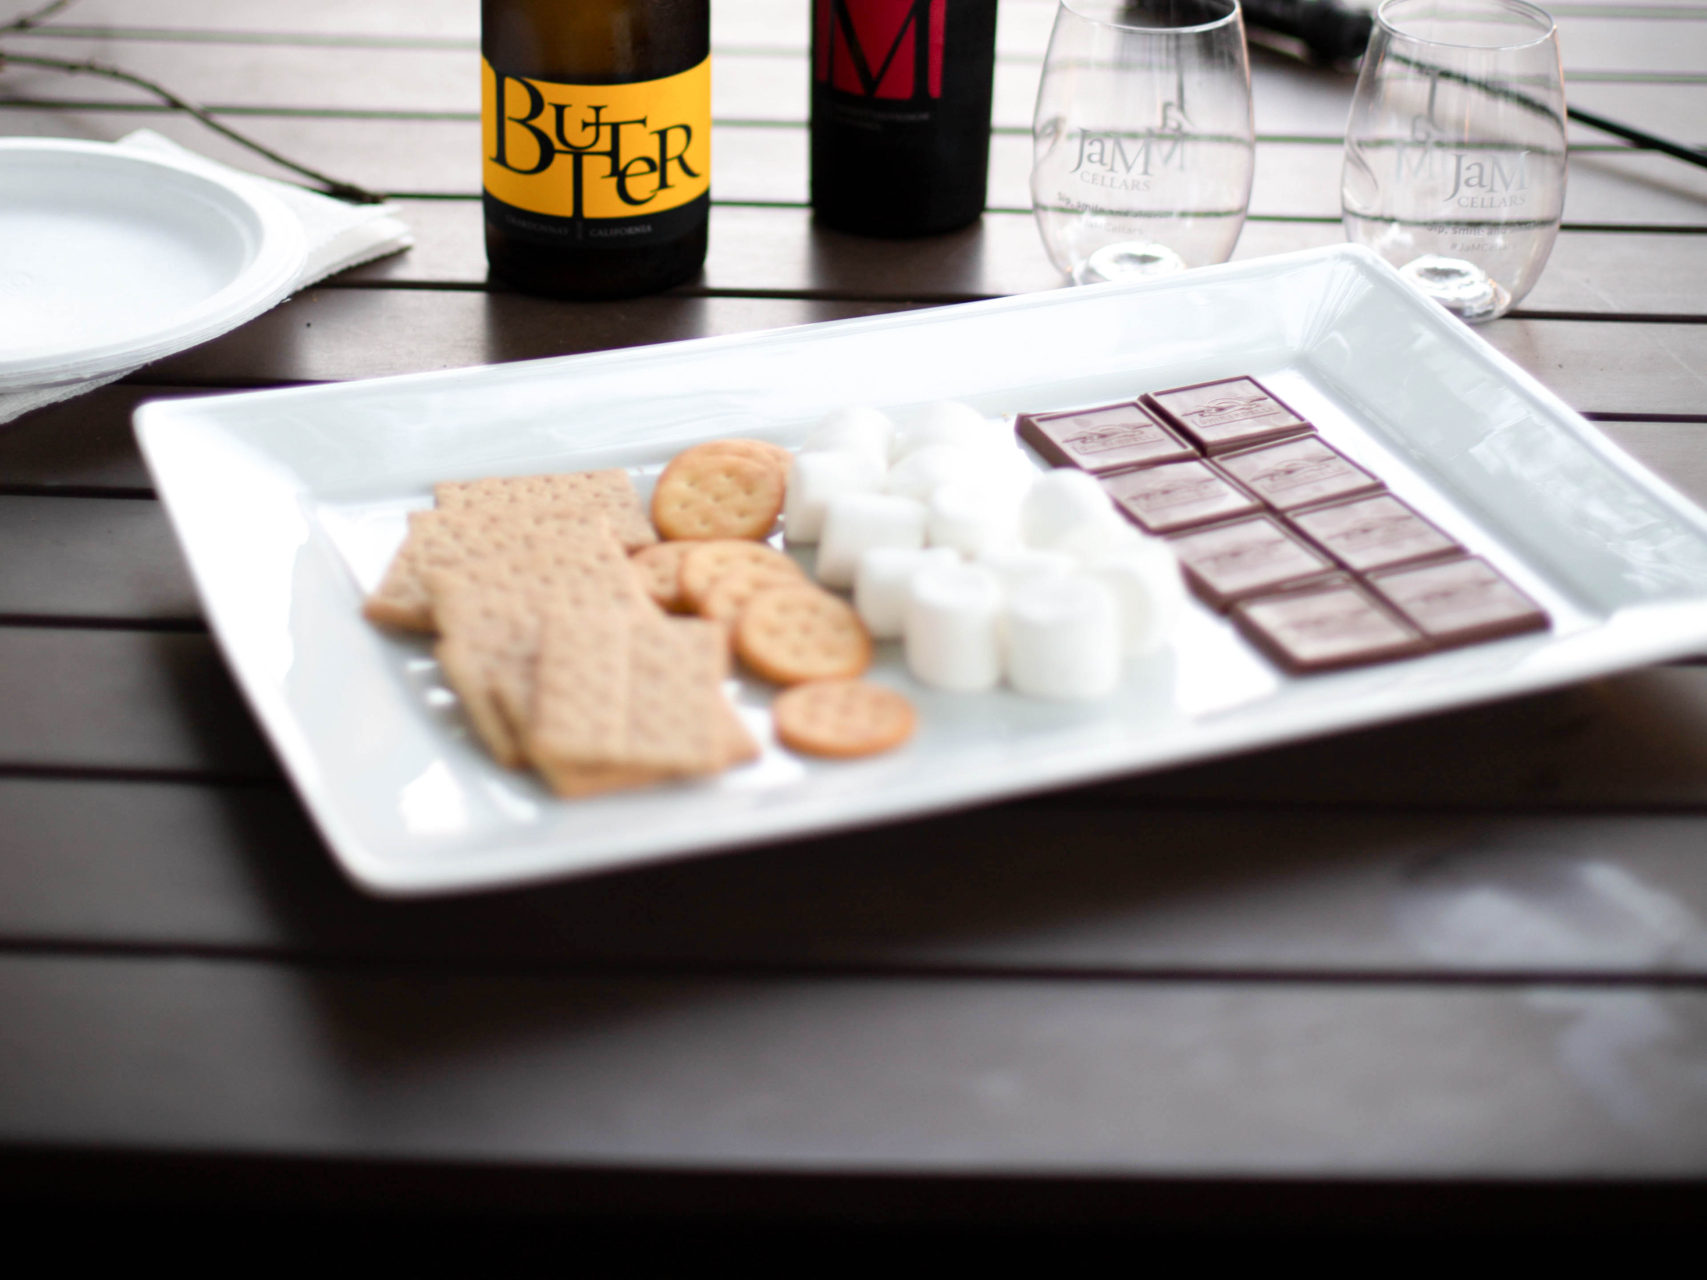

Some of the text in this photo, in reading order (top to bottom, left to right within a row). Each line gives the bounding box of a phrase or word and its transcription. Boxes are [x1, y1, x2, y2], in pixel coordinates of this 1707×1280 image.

[1069, 127, 1154, 177] JaM
[1079, 169, 1152, 192] CELLARS
[1443, 150, 1530, 202] JaM
[1457, 193, 1527, 210] CELLARS
[589, 222, 655, 238] CALIFORNIA
